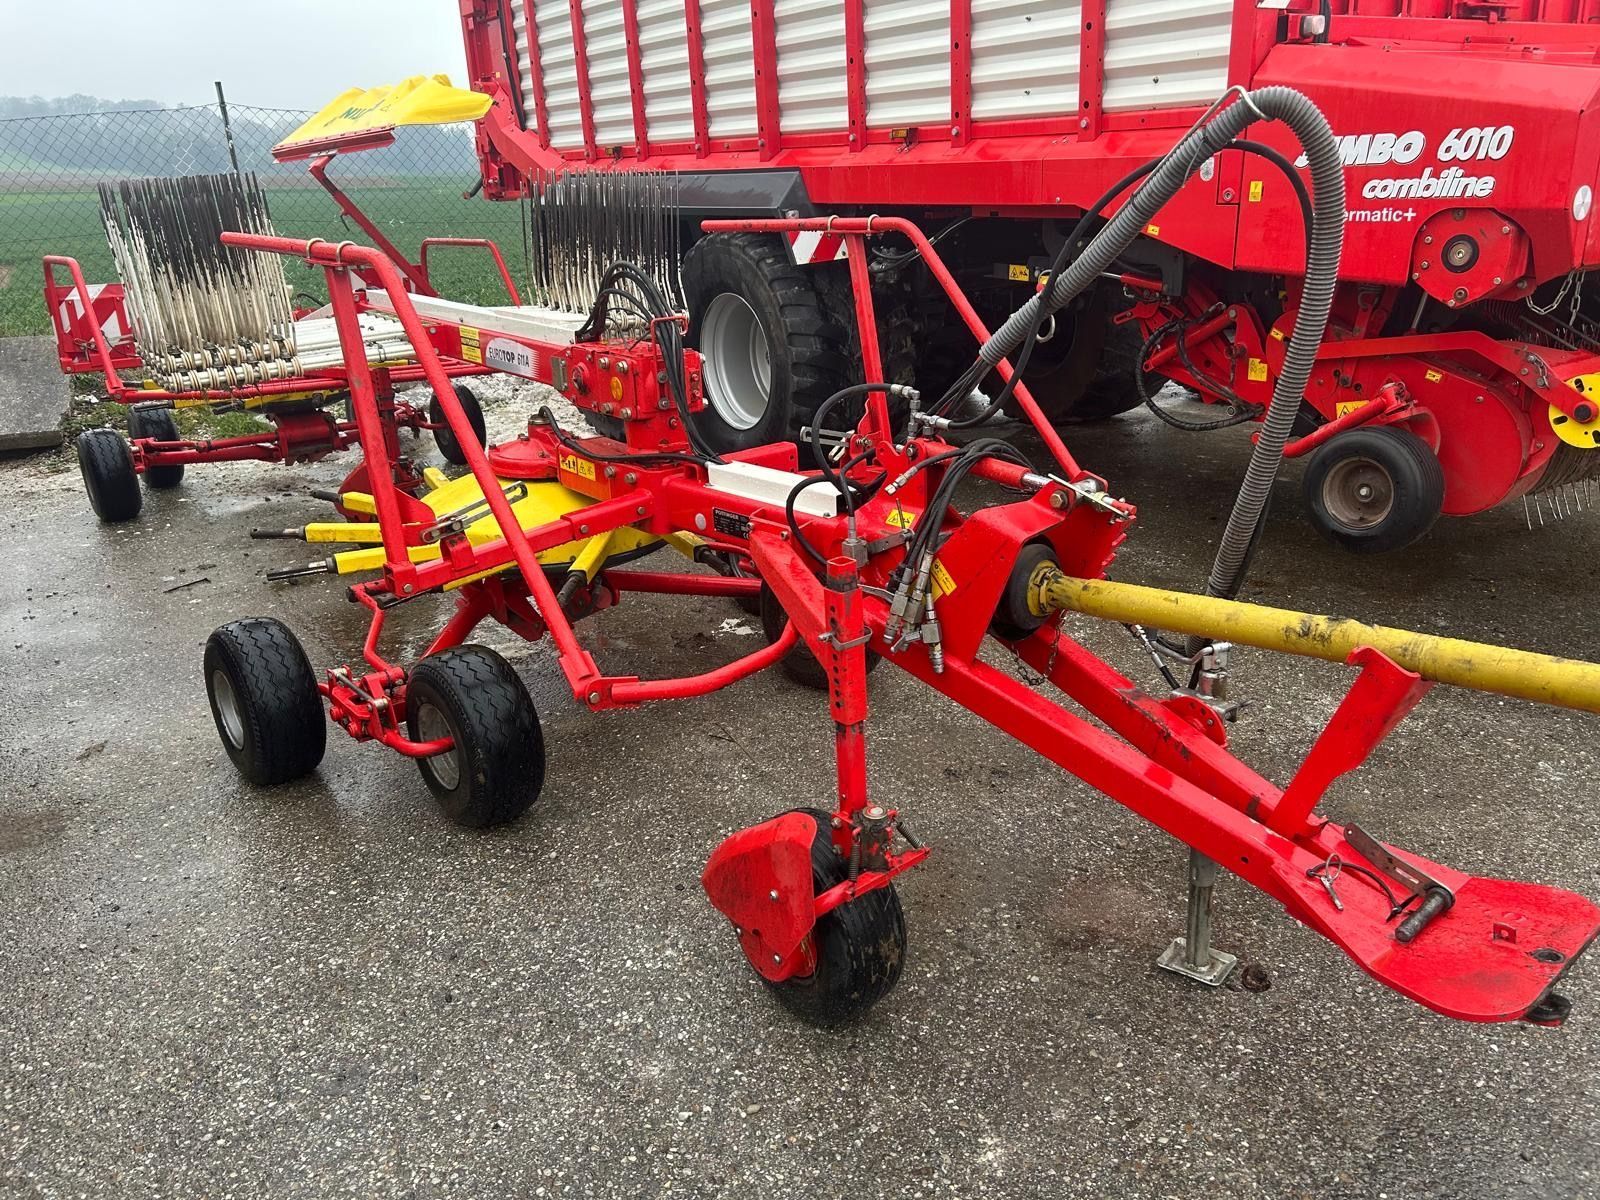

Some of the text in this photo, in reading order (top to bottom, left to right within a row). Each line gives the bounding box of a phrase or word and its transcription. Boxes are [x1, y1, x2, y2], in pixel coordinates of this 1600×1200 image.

[1437, 125, 1515, 161] 6010
[1361, 167, 1496, 200] combiline
[1344, 207, 1417, 222] ermatic+
[488, 346, 516, 364] EUROTOP
